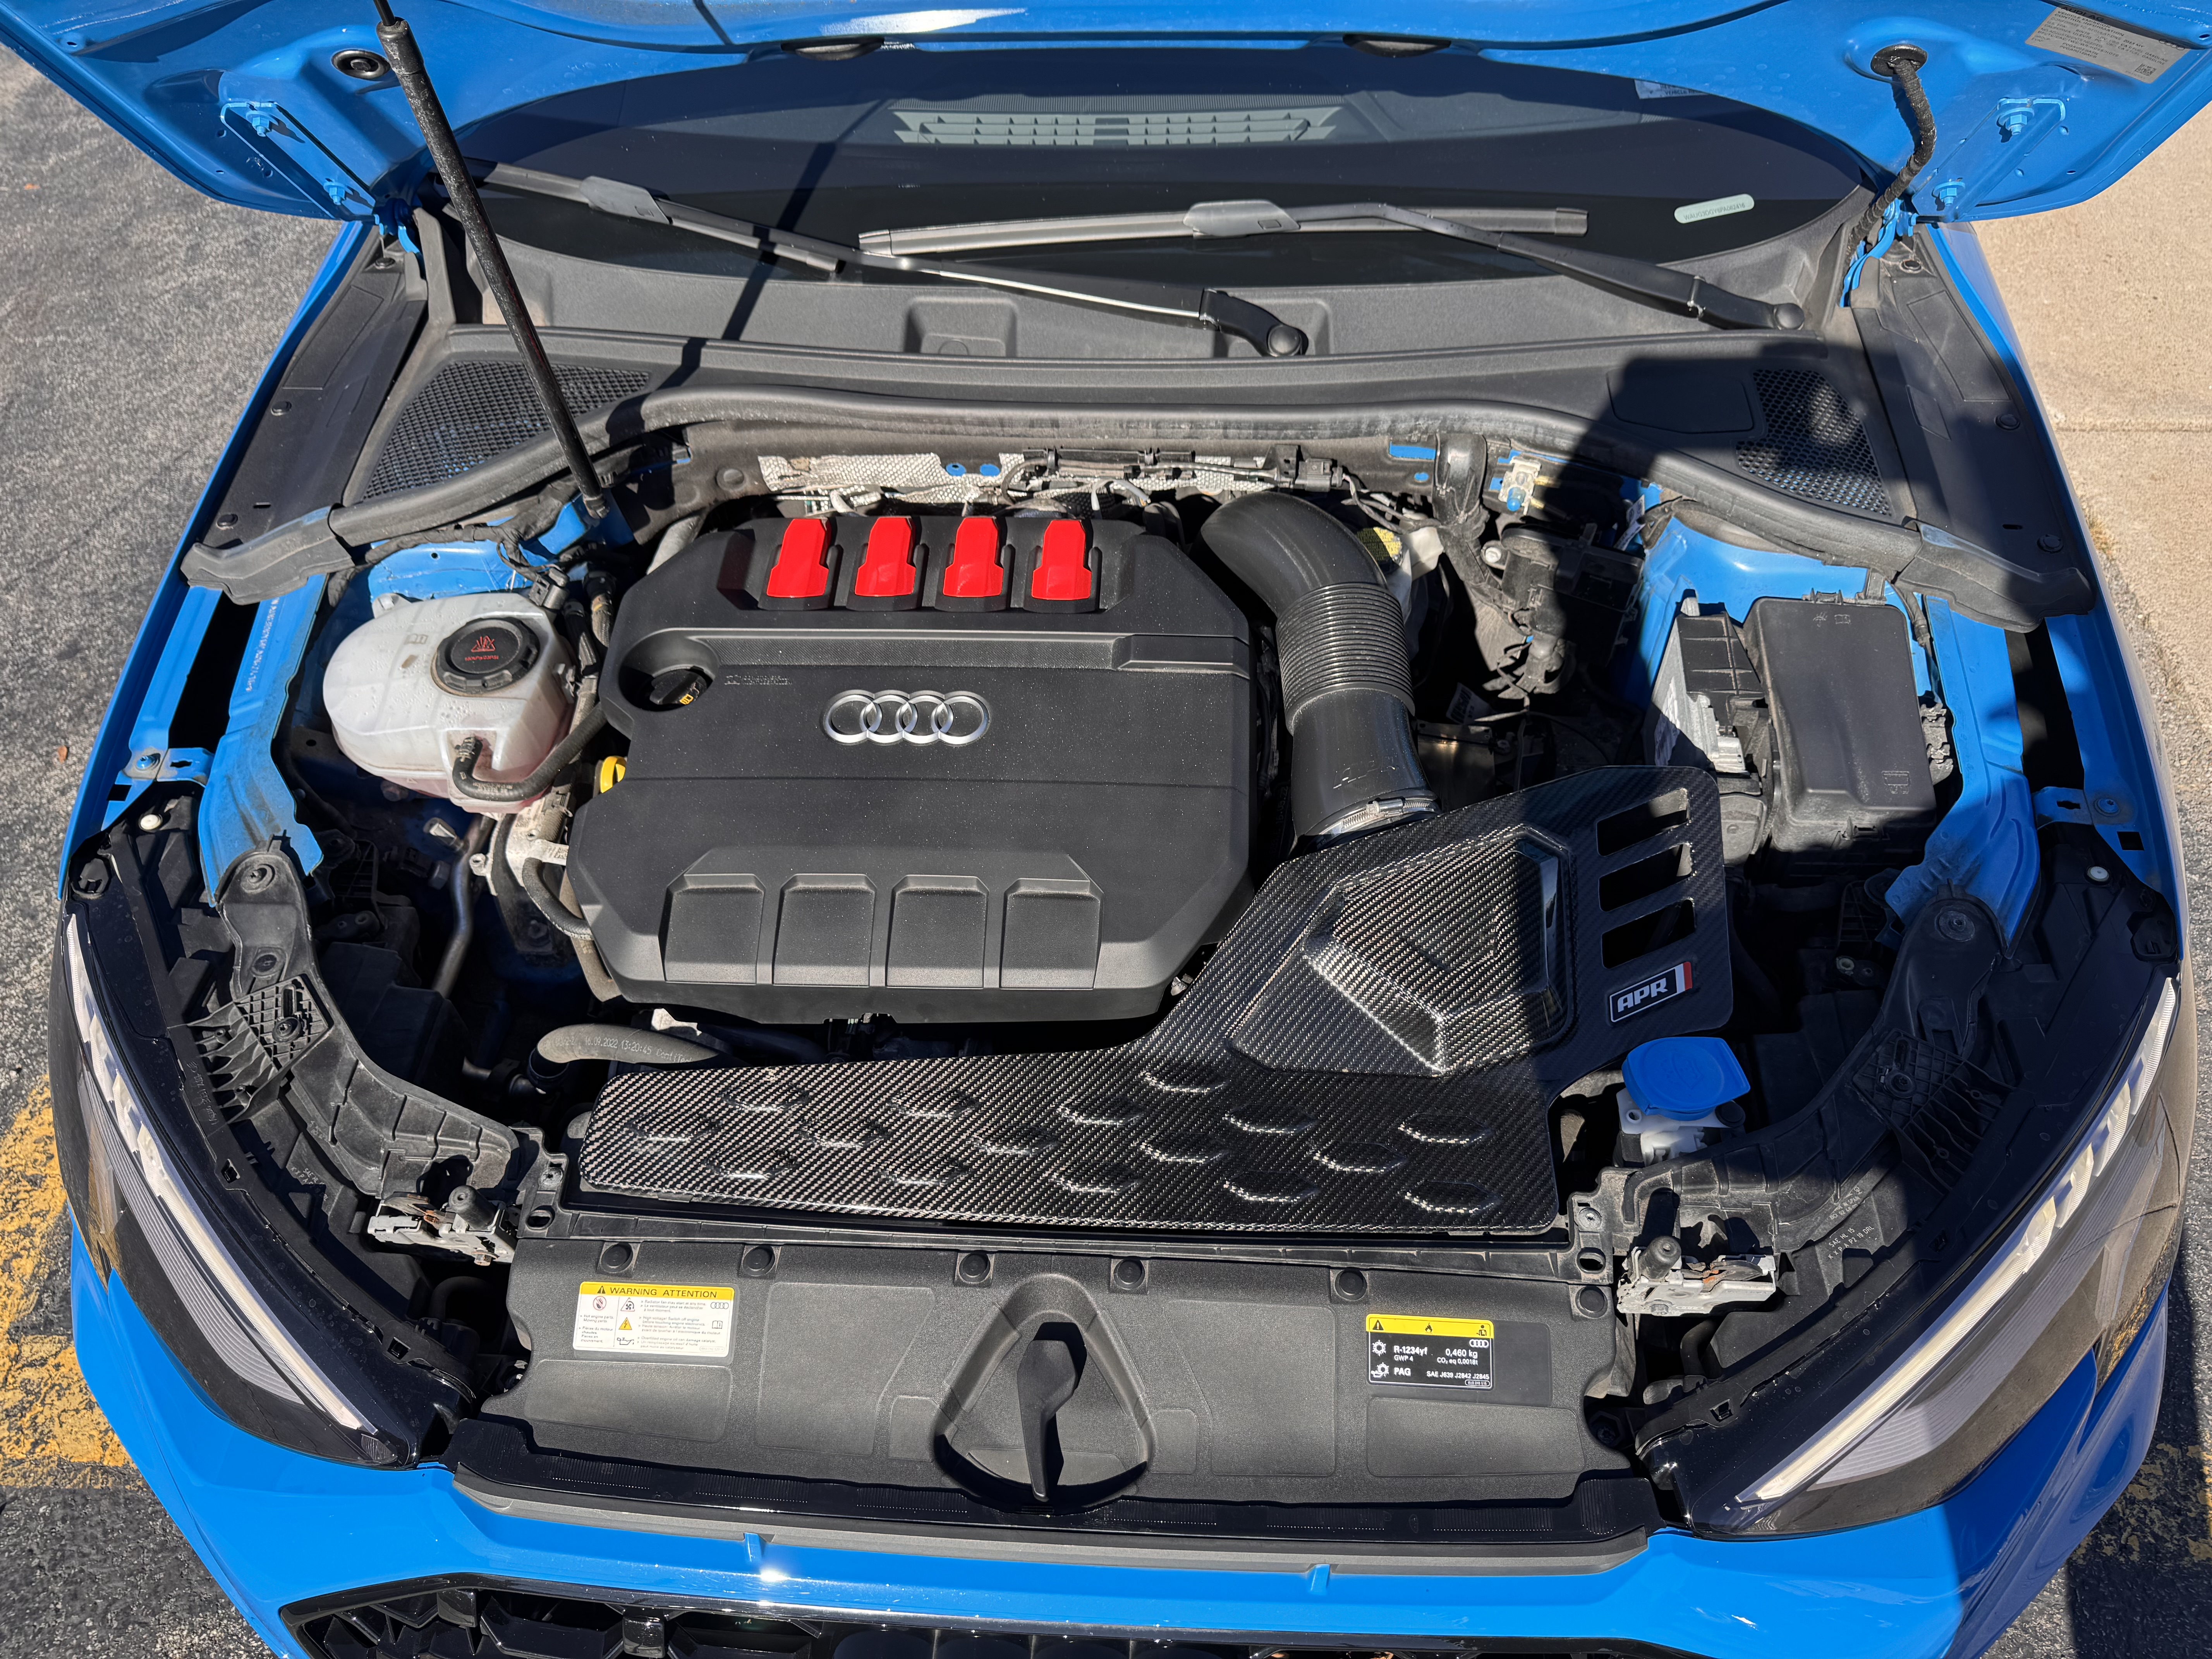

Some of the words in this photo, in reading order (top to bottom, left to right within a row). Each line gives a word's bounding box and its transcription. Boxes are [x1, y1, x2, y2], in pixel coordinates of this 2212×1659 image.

[2057, 10, 2081, 20] VEHICLE
[2081, 17, 2111, 28] EMISSION
[2061, 5, 2087, 17] AUDI
[2089, 14, 2104, 22] AG
[2054, 14, 2081, 23] CONTROL
[2083, 21, 2124, 36] INFORMATION
[1618, 977, 1668, 1012] APR
[585, 1036, 618, 1049] 16.09.2022
[621, 1039, 652, 1055] 13:20:45
[303, 1168, 314, 1178] SAE
[1829, 1237, 1841, 1248] SAE
[1848, 1237, 1857, 1245] P2
[1863, 1225, 1874, 1235] DRL
[610, 1287, 657, 1296] WARNING
[663, 1290, 717, 1298] ATTENTION
[1394, 1345, 1428, 1356] R-1234yf
[1445, 1348, 1467, 1357] 0,460
[1468, 1349, 1478, 1358] kg
[1394, 1367, 1411, 1376] PAG
